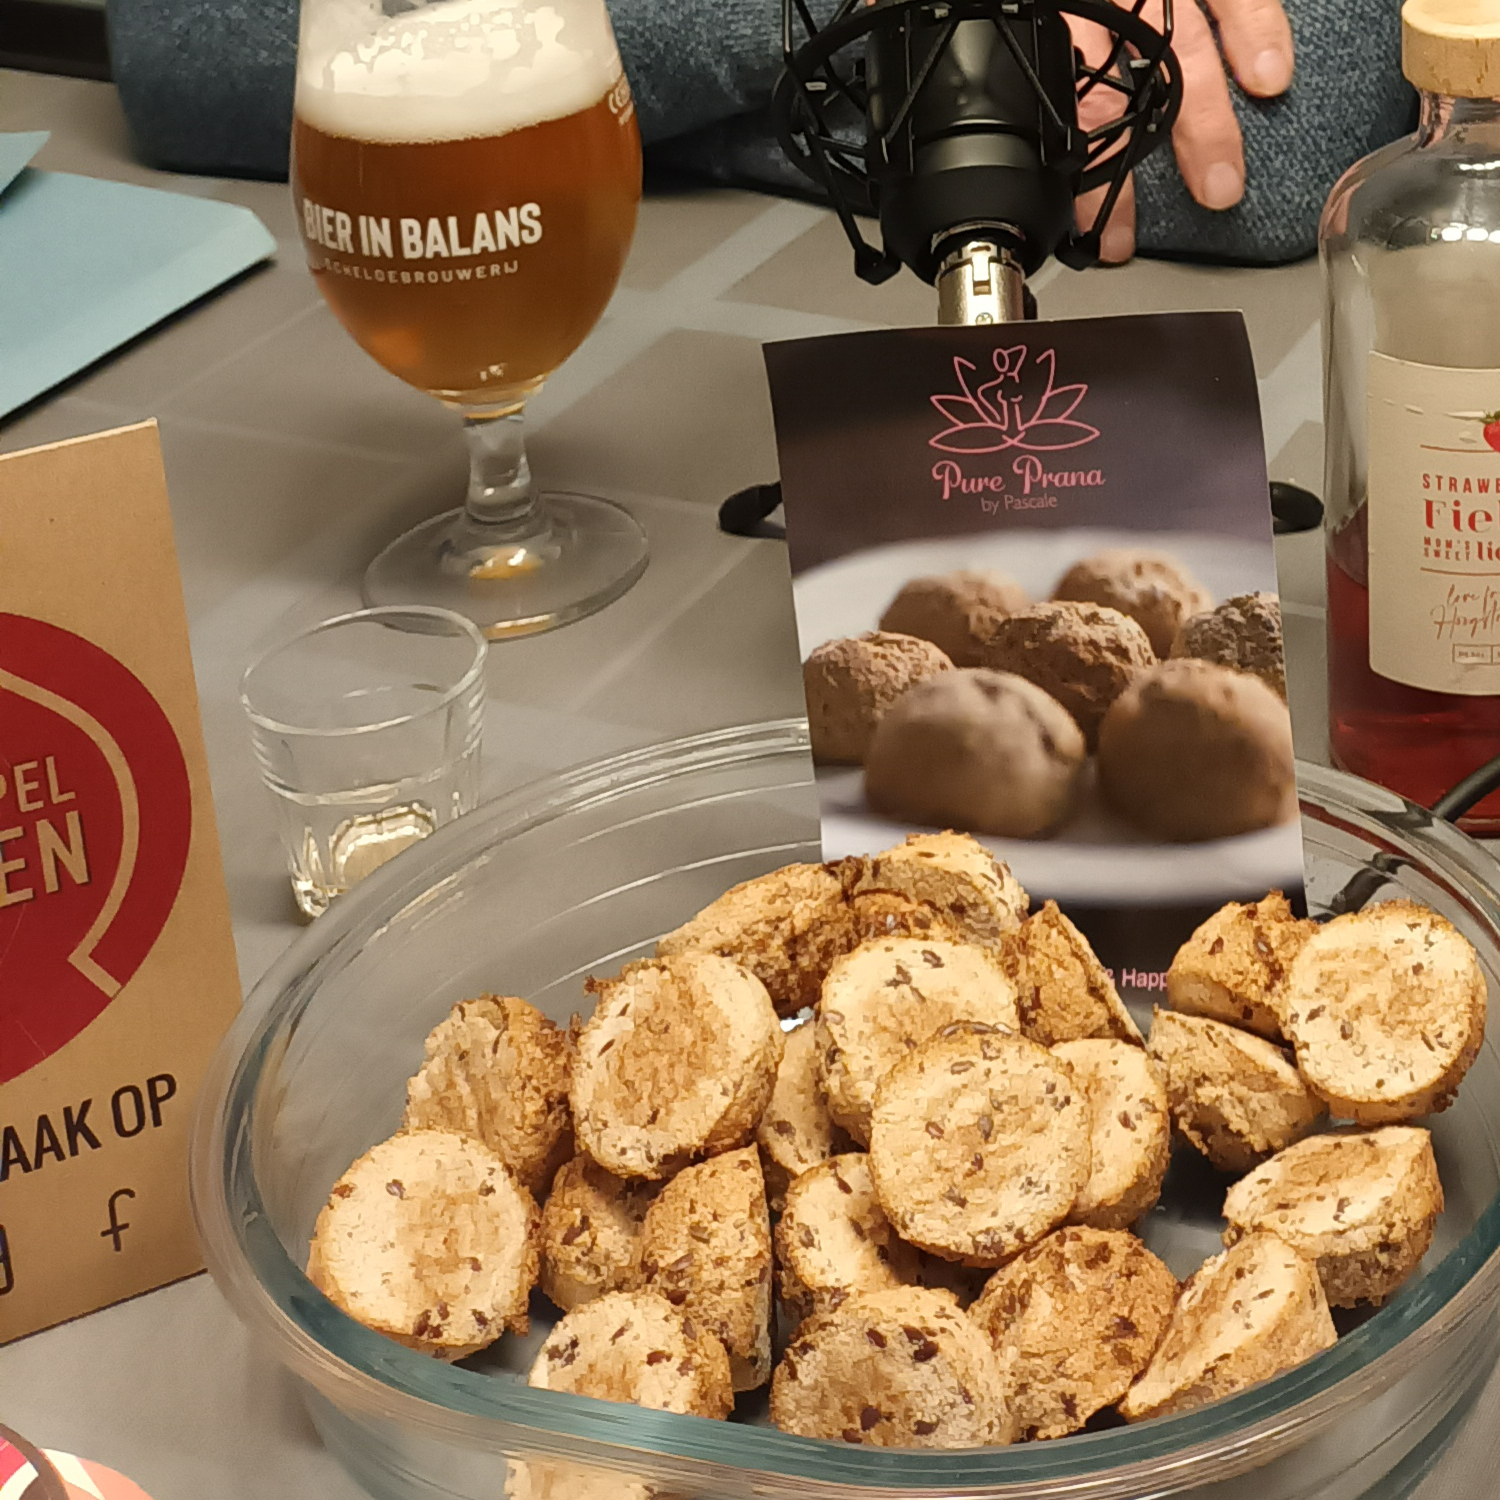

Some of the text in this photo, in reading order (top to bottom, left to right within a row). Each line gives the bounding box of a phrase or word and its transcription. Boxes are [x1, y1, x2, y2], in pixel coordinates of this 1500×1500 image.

[302, 197, 543, 260] BIER IN BALANS
[931, 454, 1106, 500] Pure Prana
[980, 493, 1058, 515] by Pascale
[111, 1073, 177, 1138] OP
